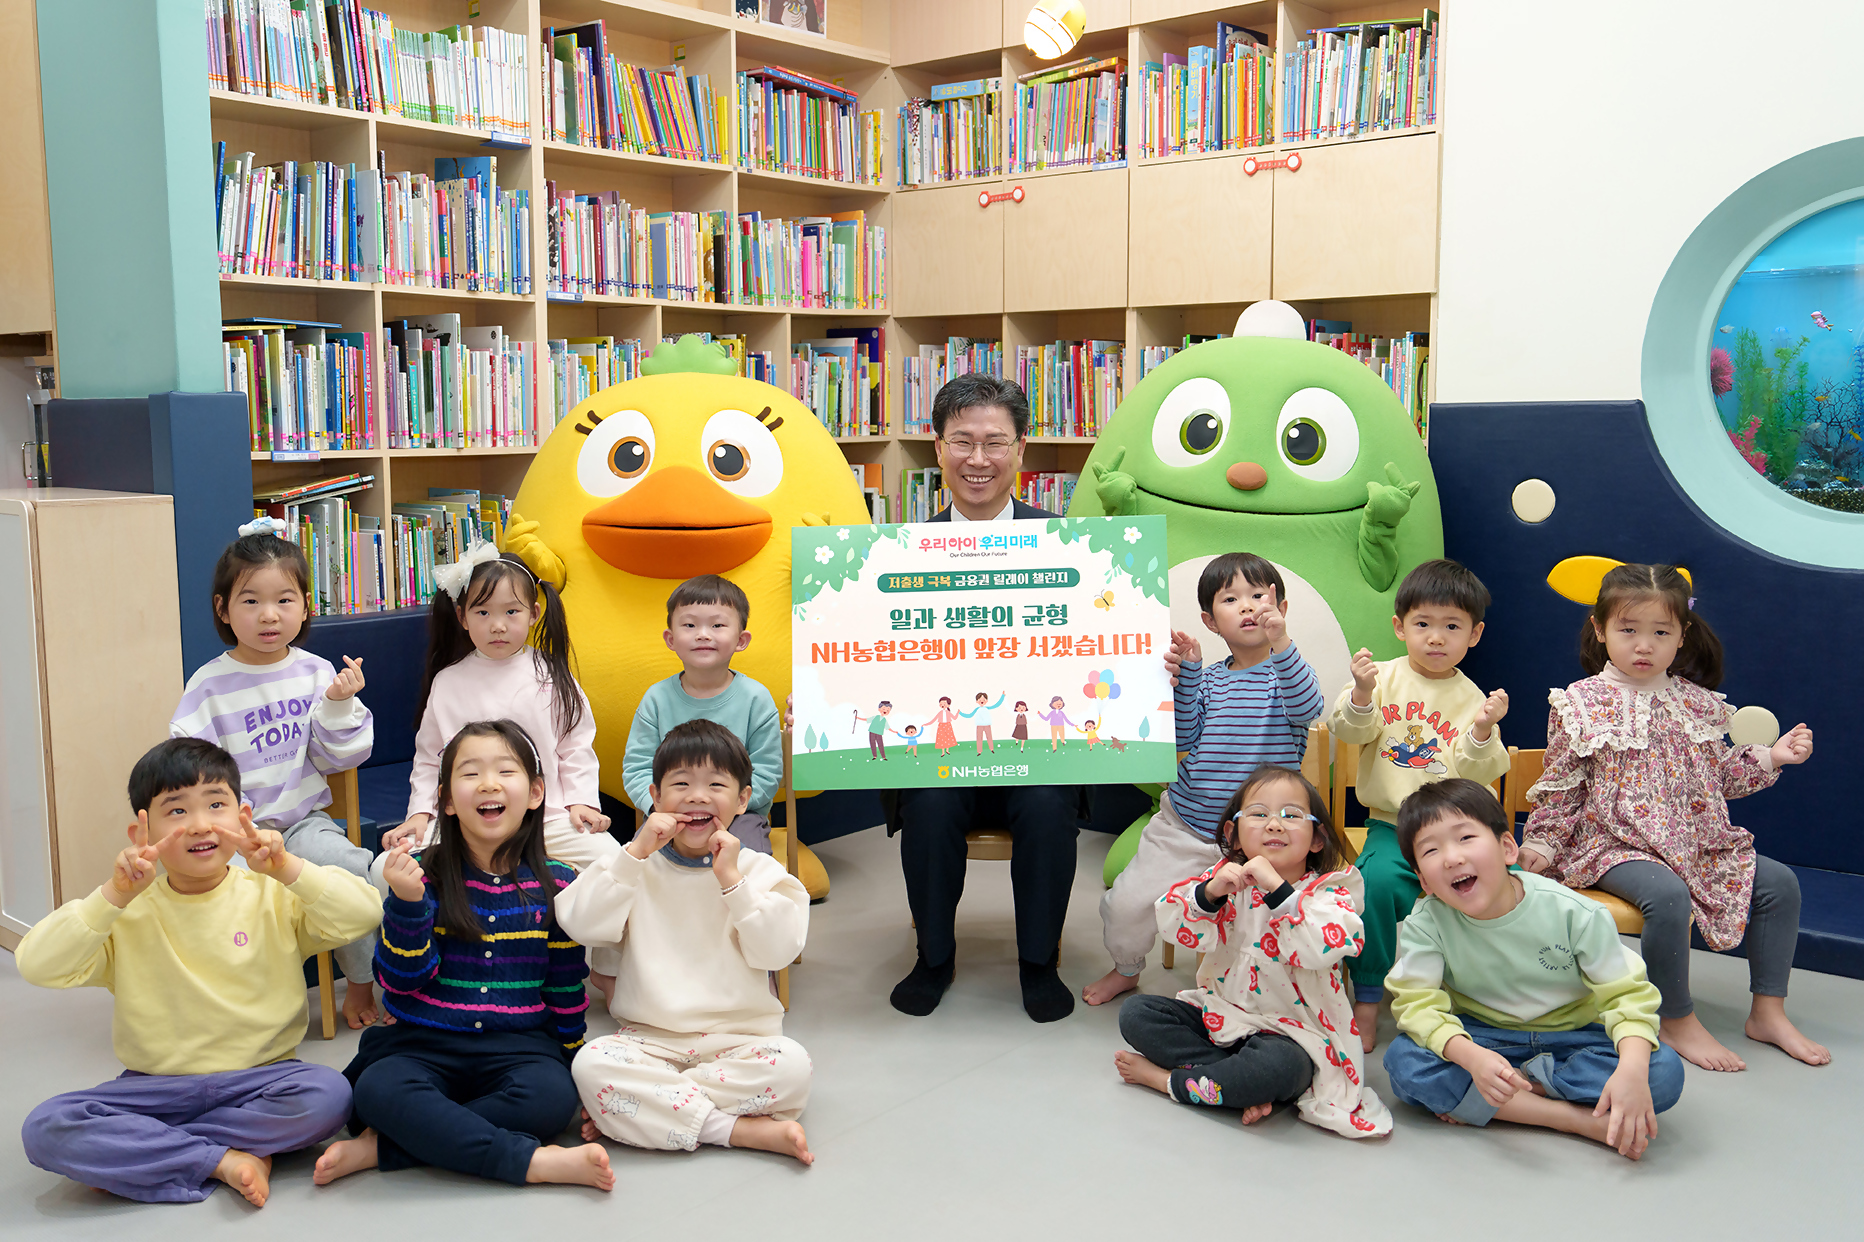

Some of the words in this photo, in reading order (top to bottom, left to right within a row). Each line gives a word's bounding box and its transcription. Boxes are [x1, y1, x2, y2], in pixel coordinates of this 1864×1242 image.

[888, 575, 924, 589] 저출생
[927, 574, 952, 588] 극복
[954, 573, 990, 587] 금융권
[993, 572, 1029, 586] 릴레이
[1032, 570, 1068, 585] 챌린지
[889, 607, 937, 631] 일과
[943, 605, 1014, 629] 생활의
[1021, 603, 1069, 627] 균형
[811, 638, 966, 664] NH농협은행이
[973, 636, 1022, 660] 앞장
[1026, 632, 1152, 658] 서겠습니다!
[244, 698, 312, 734] ENJOY
[1381, 703, 1402, 726] IR
[250, 721, 305, 754] TODA
[951, 764, 1029, 778] NH농협은행
